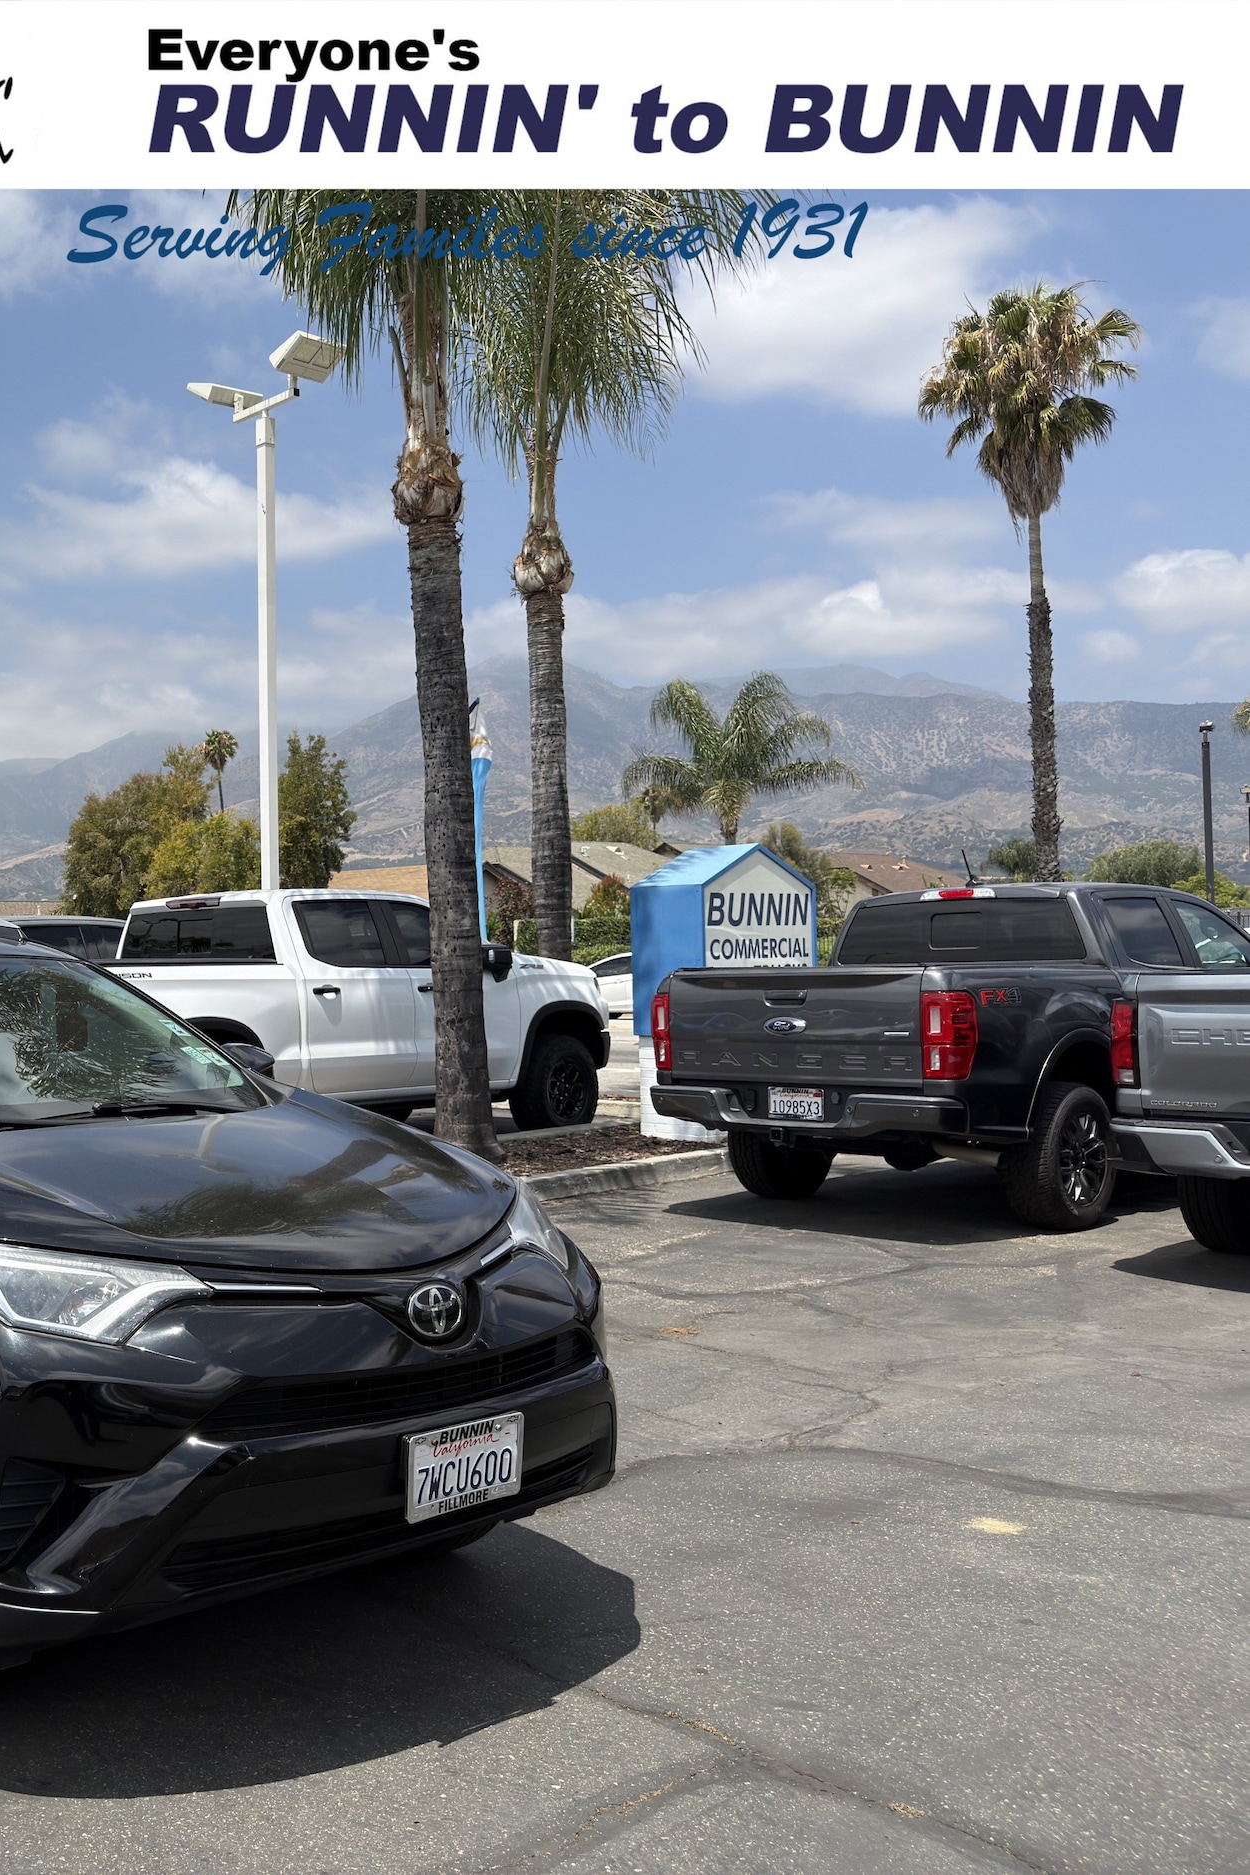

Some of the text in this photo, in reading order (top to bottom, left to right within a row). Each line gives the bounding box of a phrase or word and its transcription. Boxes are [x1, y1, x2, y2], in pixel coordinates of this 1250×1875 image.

[707, 892, 809, 927] BUNNIN
[710, 938, 809, 960] COMMERCIAL
[979, 988, 1021, 1006] FX4
[678, 1051, 913, 1071] RANGER
[772, 1099, 820, 1115] 10985X3
[439, 1420, 495, 1445] BUNNIN
[432, 1433, 500, 1458] California
[418, 1447, 512, 1505] 7WCU600
[438, 1489, 489, 1513] FILLMORE
